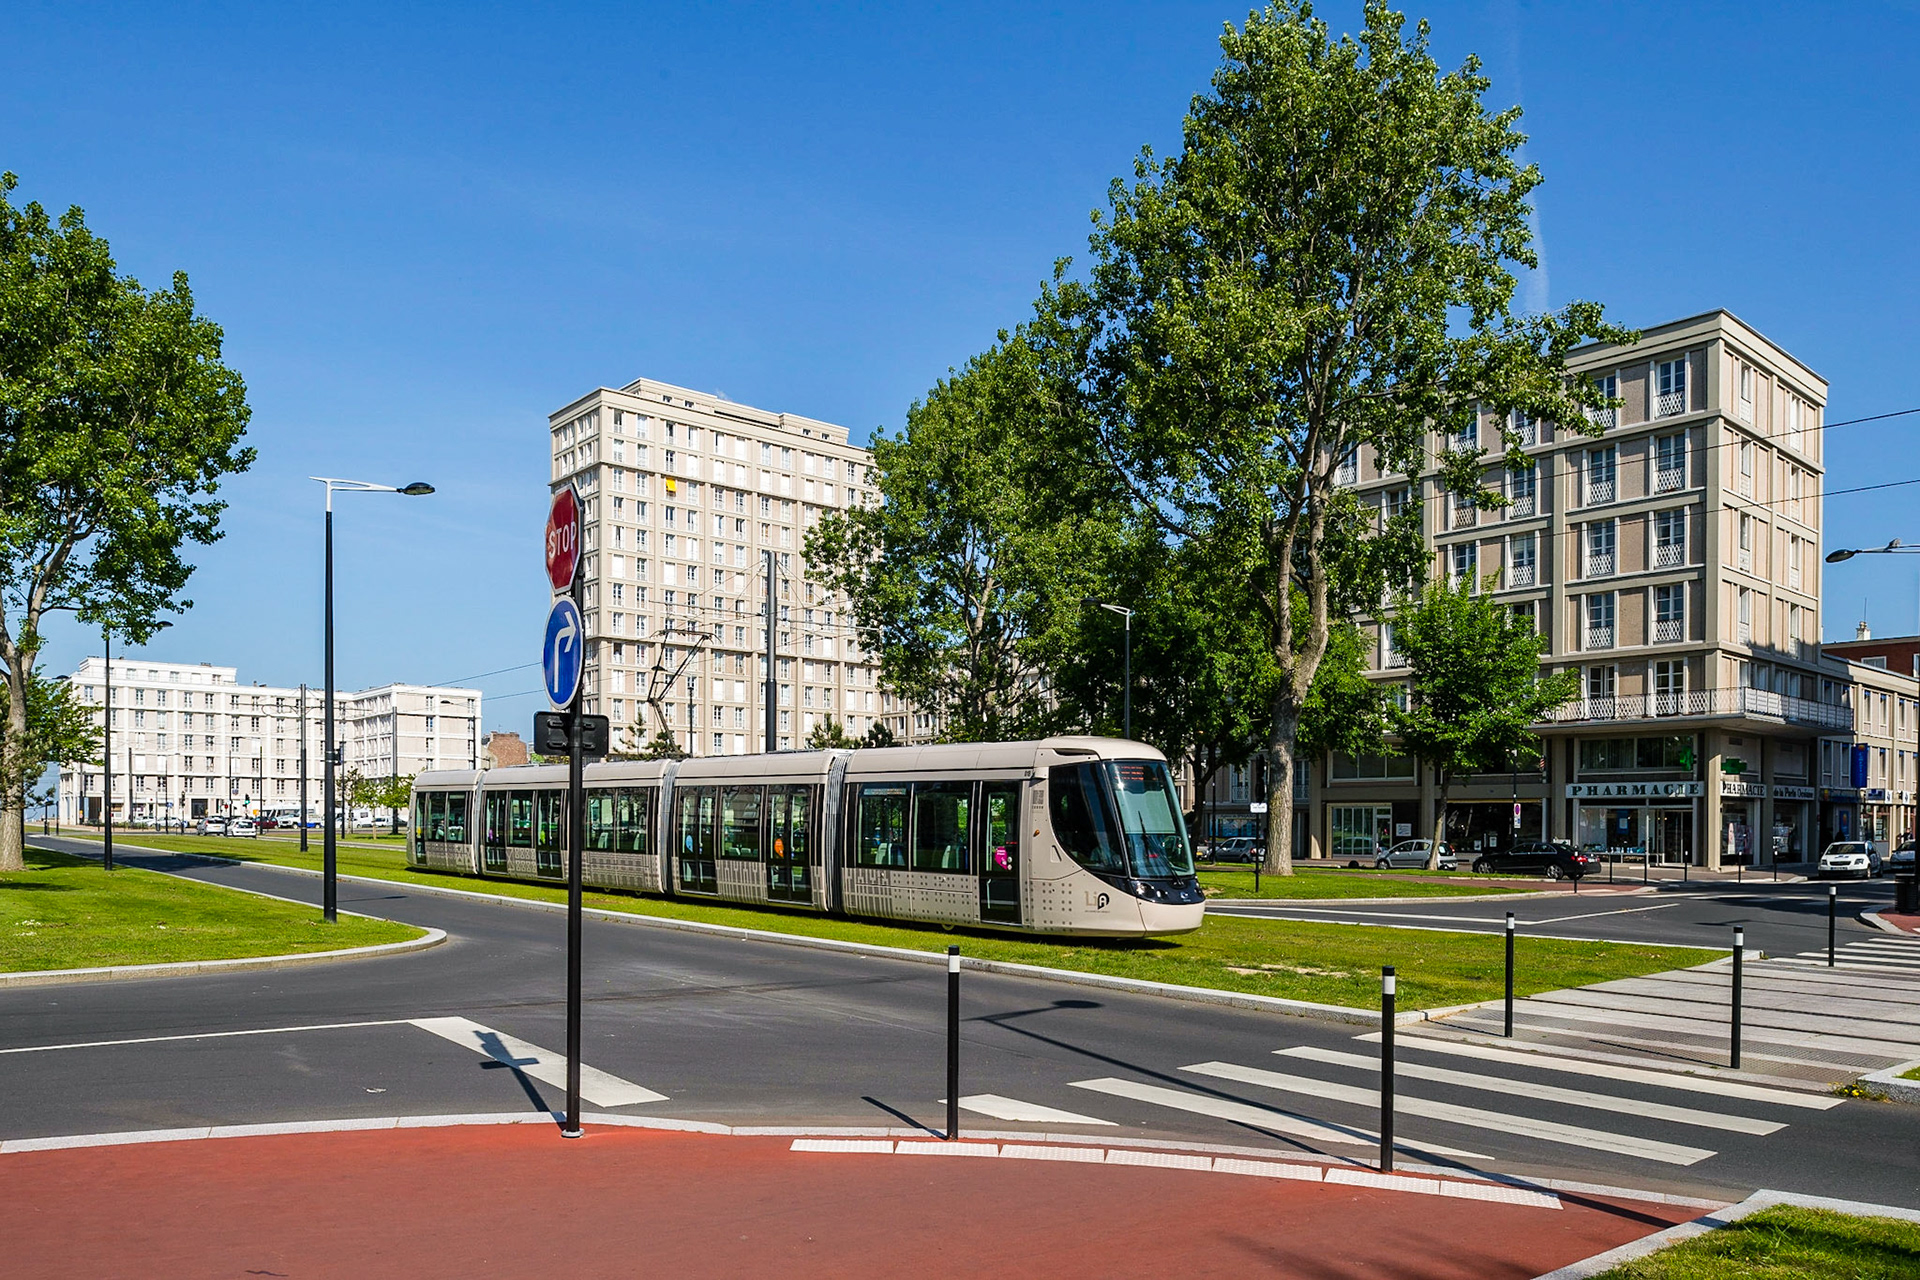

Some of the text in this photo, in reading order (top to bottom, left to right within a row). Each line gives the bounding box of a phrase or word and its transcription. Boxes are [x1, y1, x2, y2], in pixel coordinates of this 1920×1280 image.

[549, 521, 577, 559] STOP
[1571, 783, 1700, 796] PHARMACIE
[1722, 781, 1765, 796] PHARMACIE
